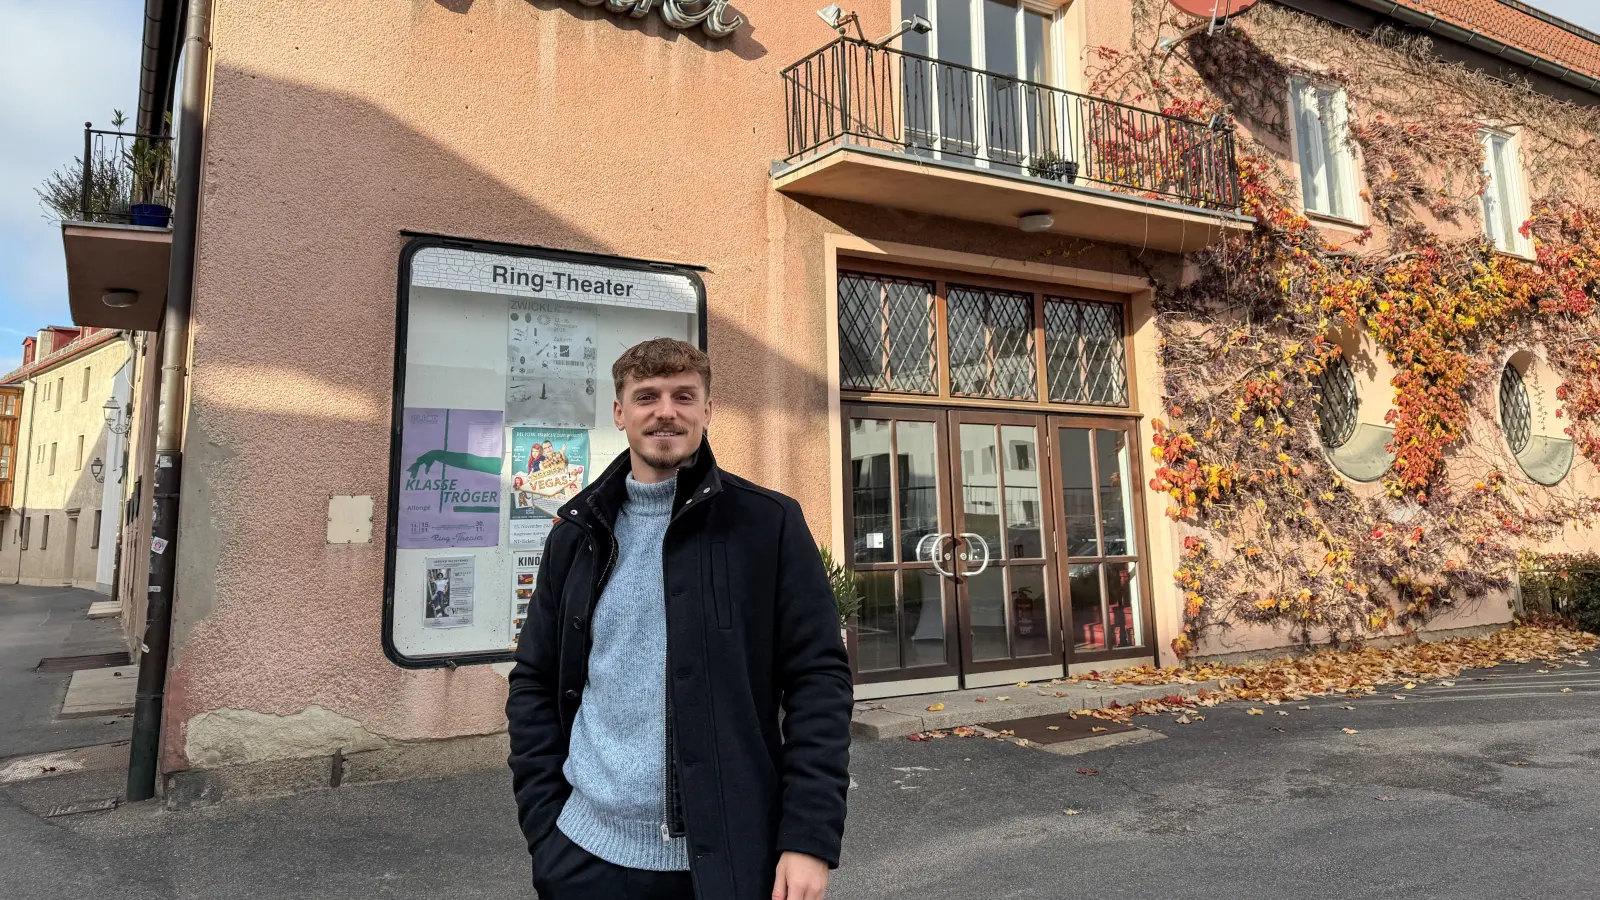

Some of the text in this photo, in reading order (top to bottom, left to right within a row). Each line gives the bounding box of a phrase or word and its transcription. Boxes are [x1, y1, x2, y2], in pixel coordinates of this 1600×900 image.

[492, 265, 633, 296] Ring-Theater
[510, 301, 552, 312] ZWICKL
[405, 479, 458, 490] KLASSE
[528, 472, 572, 490] VEGAS!
[444, 488, 498, 502] TRÖGER
[518, 556, 540, 566] KINO
